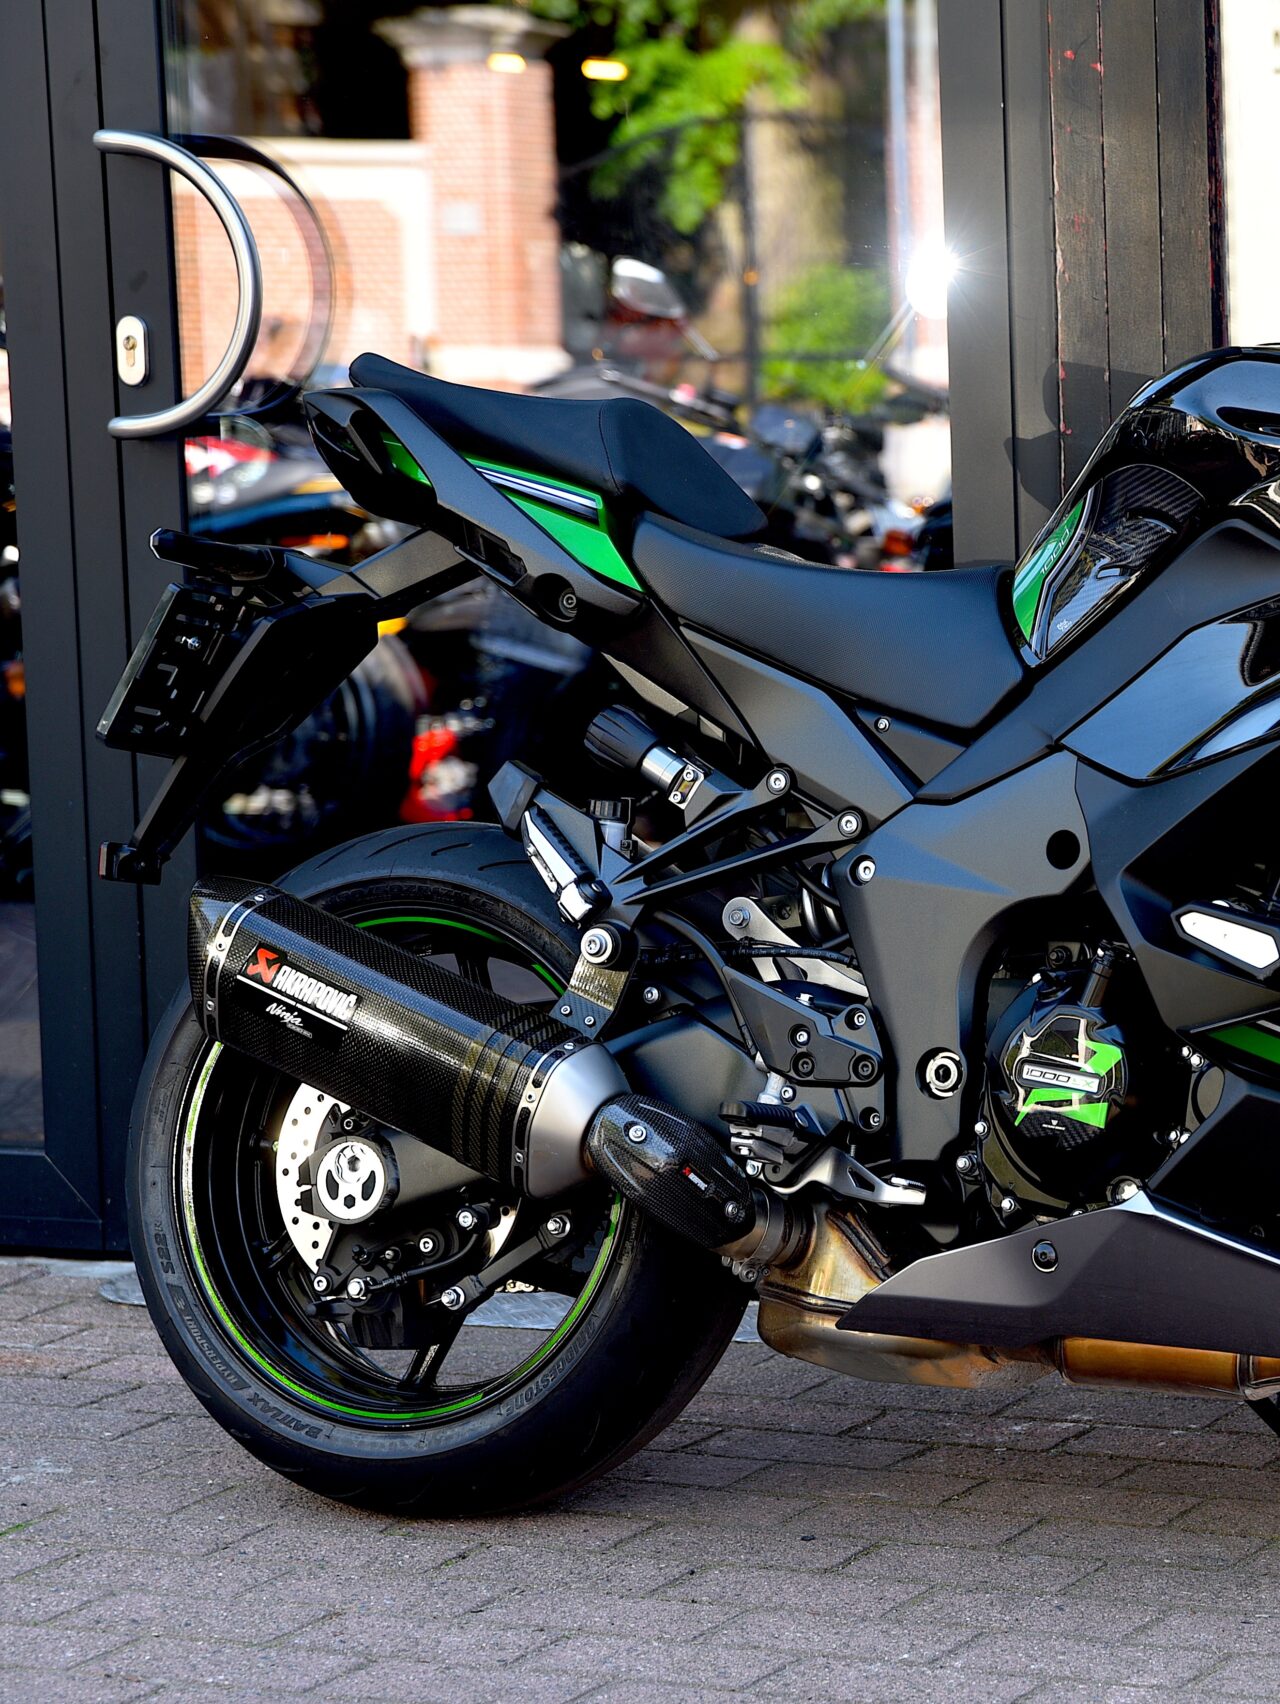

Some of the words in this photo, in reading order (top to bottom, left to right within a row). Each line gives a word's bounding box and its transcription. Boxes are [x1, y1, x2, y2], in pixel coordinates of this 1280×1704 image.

[1040, 526, 1070, 575] 1000
[266, 1003, 303, 1027] Ninja
[182, 1313, 237, 1384] HYPERSPORT
[246, 1392, 322, 1440] BATTLAX
